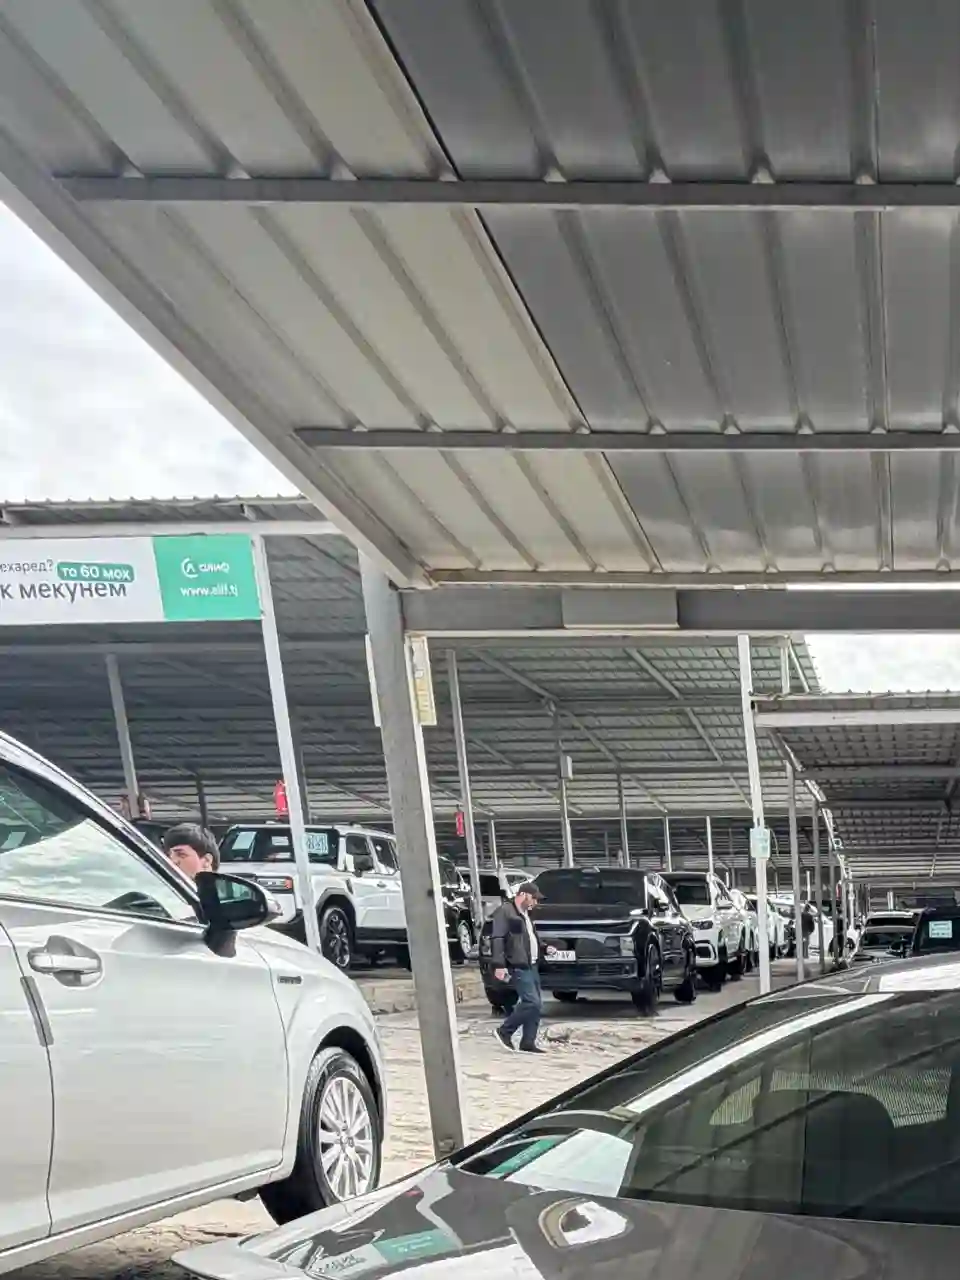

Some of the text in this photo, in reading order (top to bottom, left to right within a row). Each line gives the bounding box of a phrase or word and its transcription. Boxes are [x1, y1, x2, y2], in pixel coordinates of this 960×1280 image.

[61, 565, 131, 580] то 60 мох
[19, 582, 127, 604] мекунем
